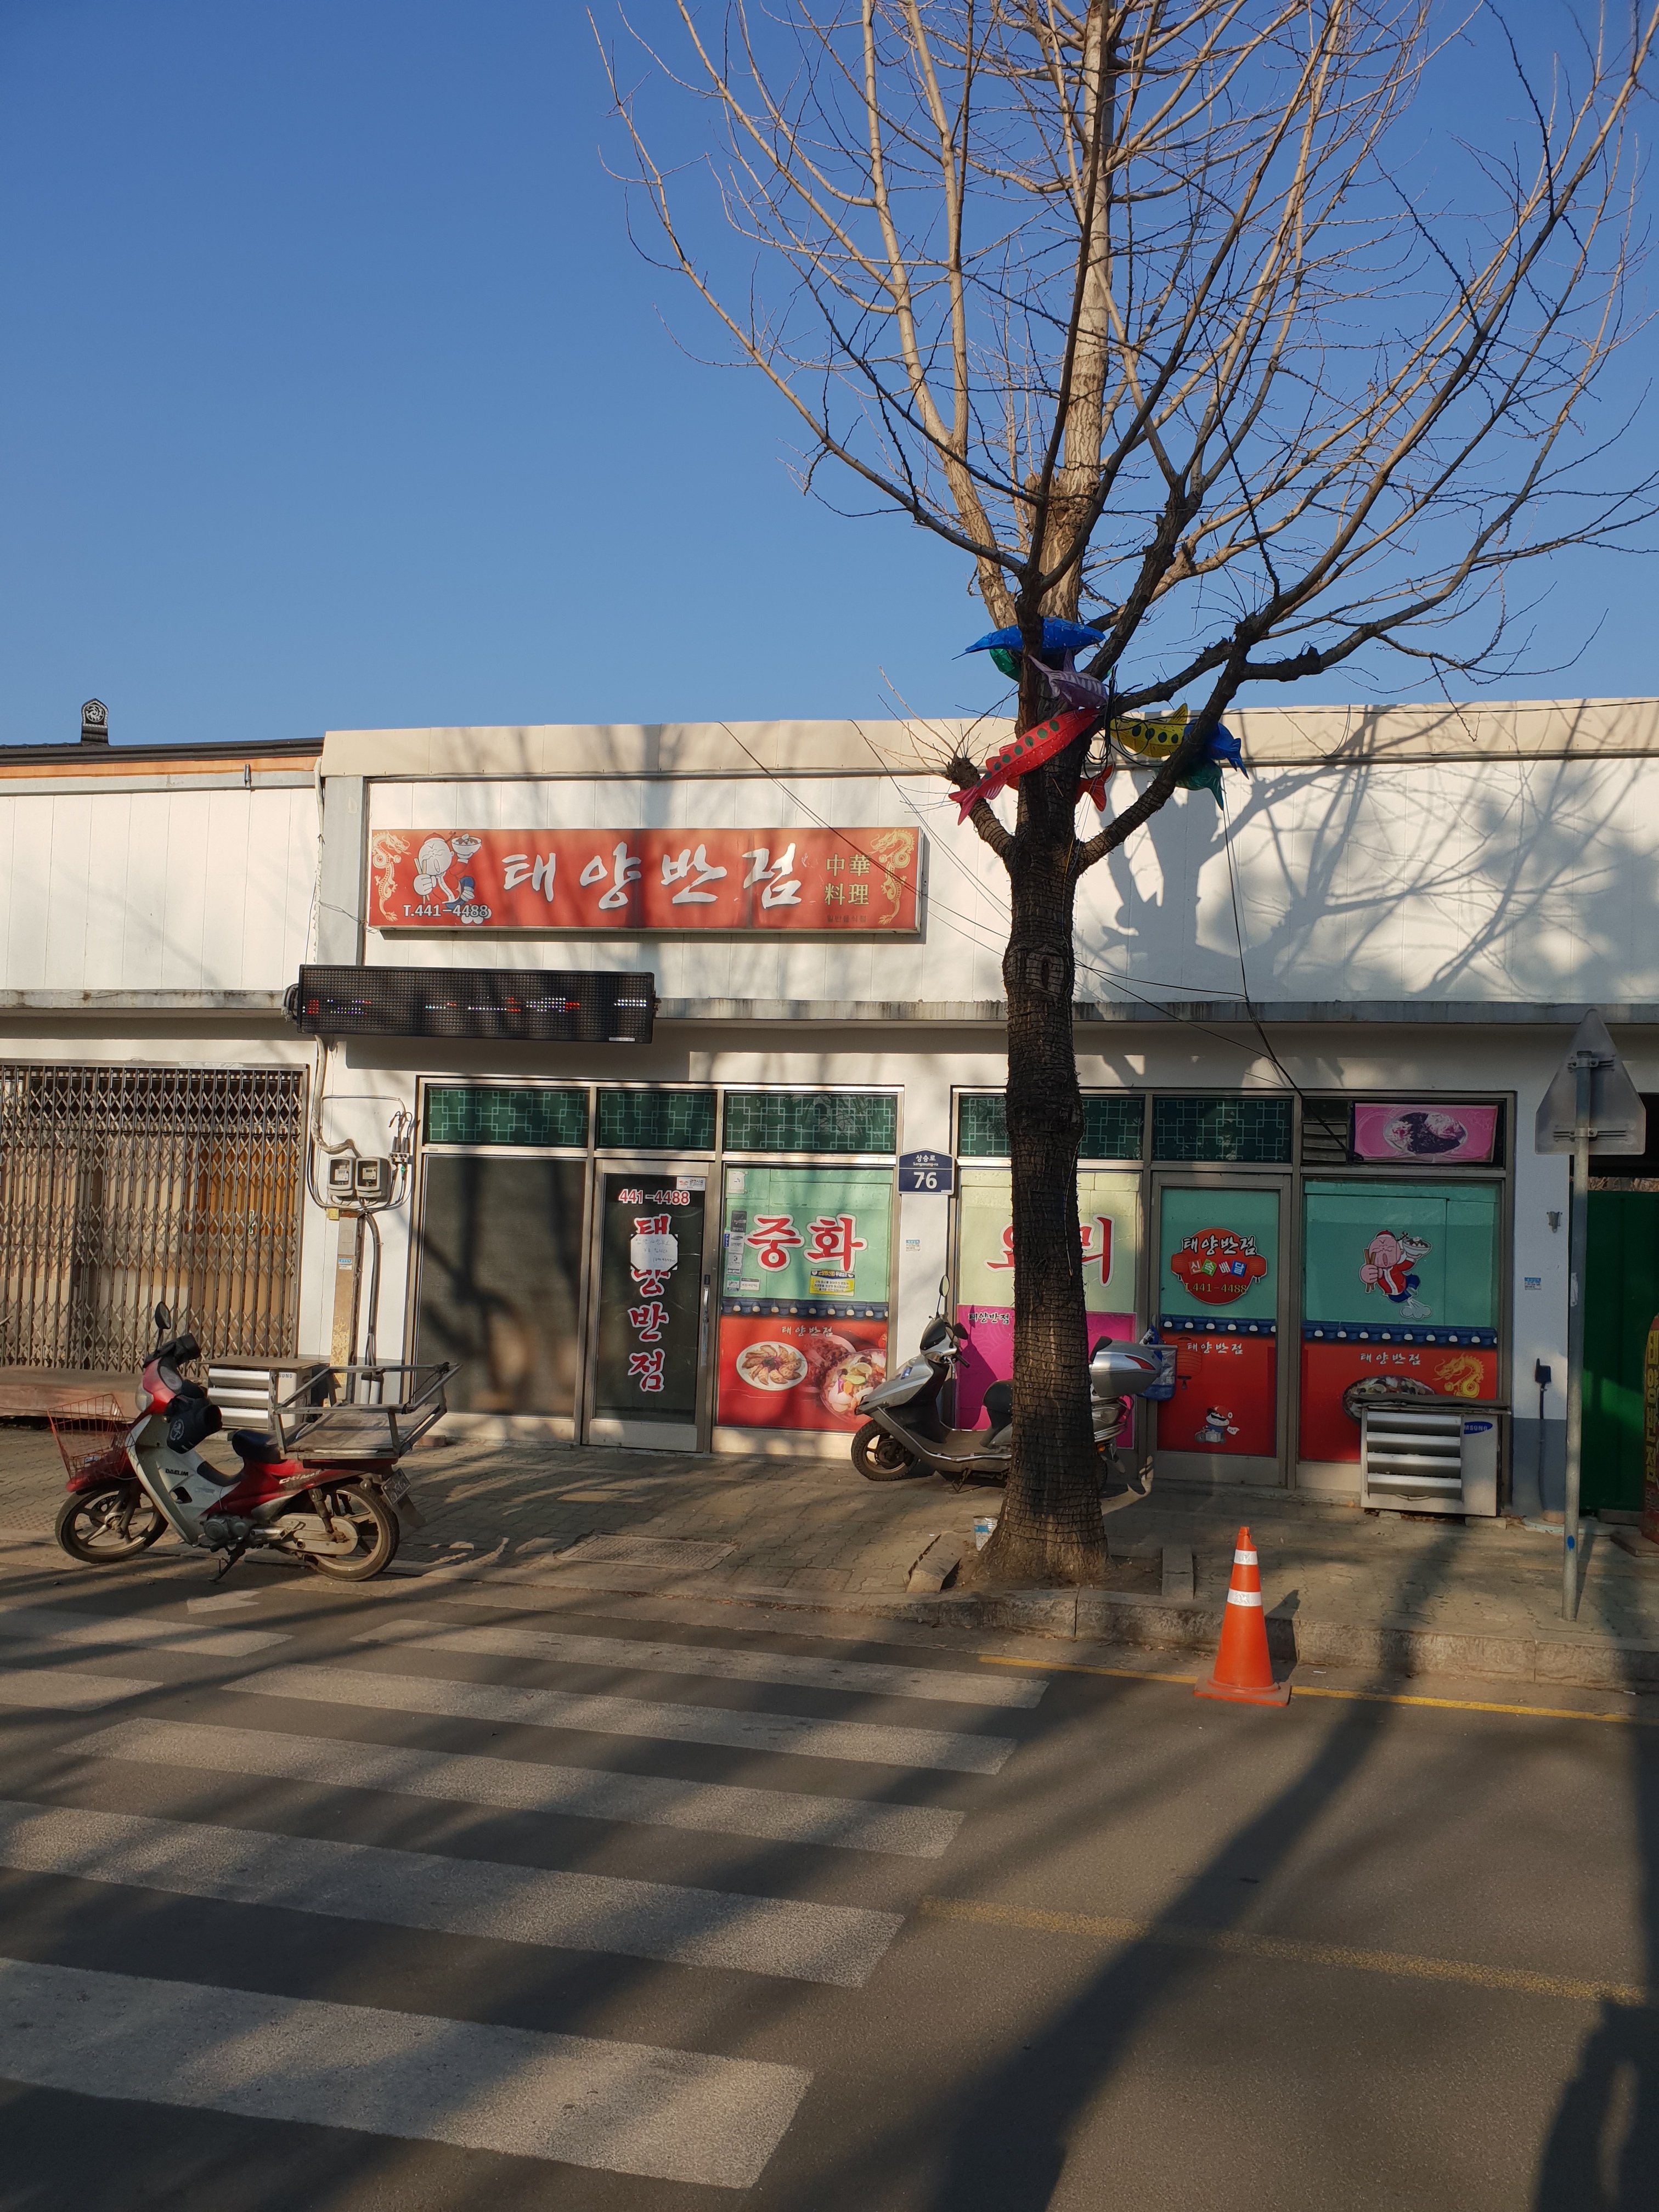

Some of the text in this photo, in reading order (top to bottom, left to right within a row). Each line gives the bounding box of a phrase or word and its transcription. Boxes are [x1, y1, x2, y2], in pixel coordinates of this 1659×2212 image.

[826, 854, 871, 877] 中華
[501, 841, 803, 910] 태양반점
[824, 882, 870, 906] 料理
[403, 904, 489, 917] T.441-4488
[915, 1154, 936, 1163] 상승로
[913, 1171, 938, 1189] 76
[618, 1188, 691, 1206] 441-4488
[745, 1214, 867, 1273] 중화
[1182, 1234, 1257, 1256] 태양반점
[1190, 1260, 1245, 1275] 신속배달
[1184, 1282, 1247, 1294] T.441-4488
[968, 1311, 1010, 1324] 태양반점
[781, 1325, 834, 1338] 태양반점
[1187, 1341, 1244, 1355] 태양반점
[1360, 1351, 1421, 1365] 태양반점
[165, 1468, 189, 1476] DAELIM
